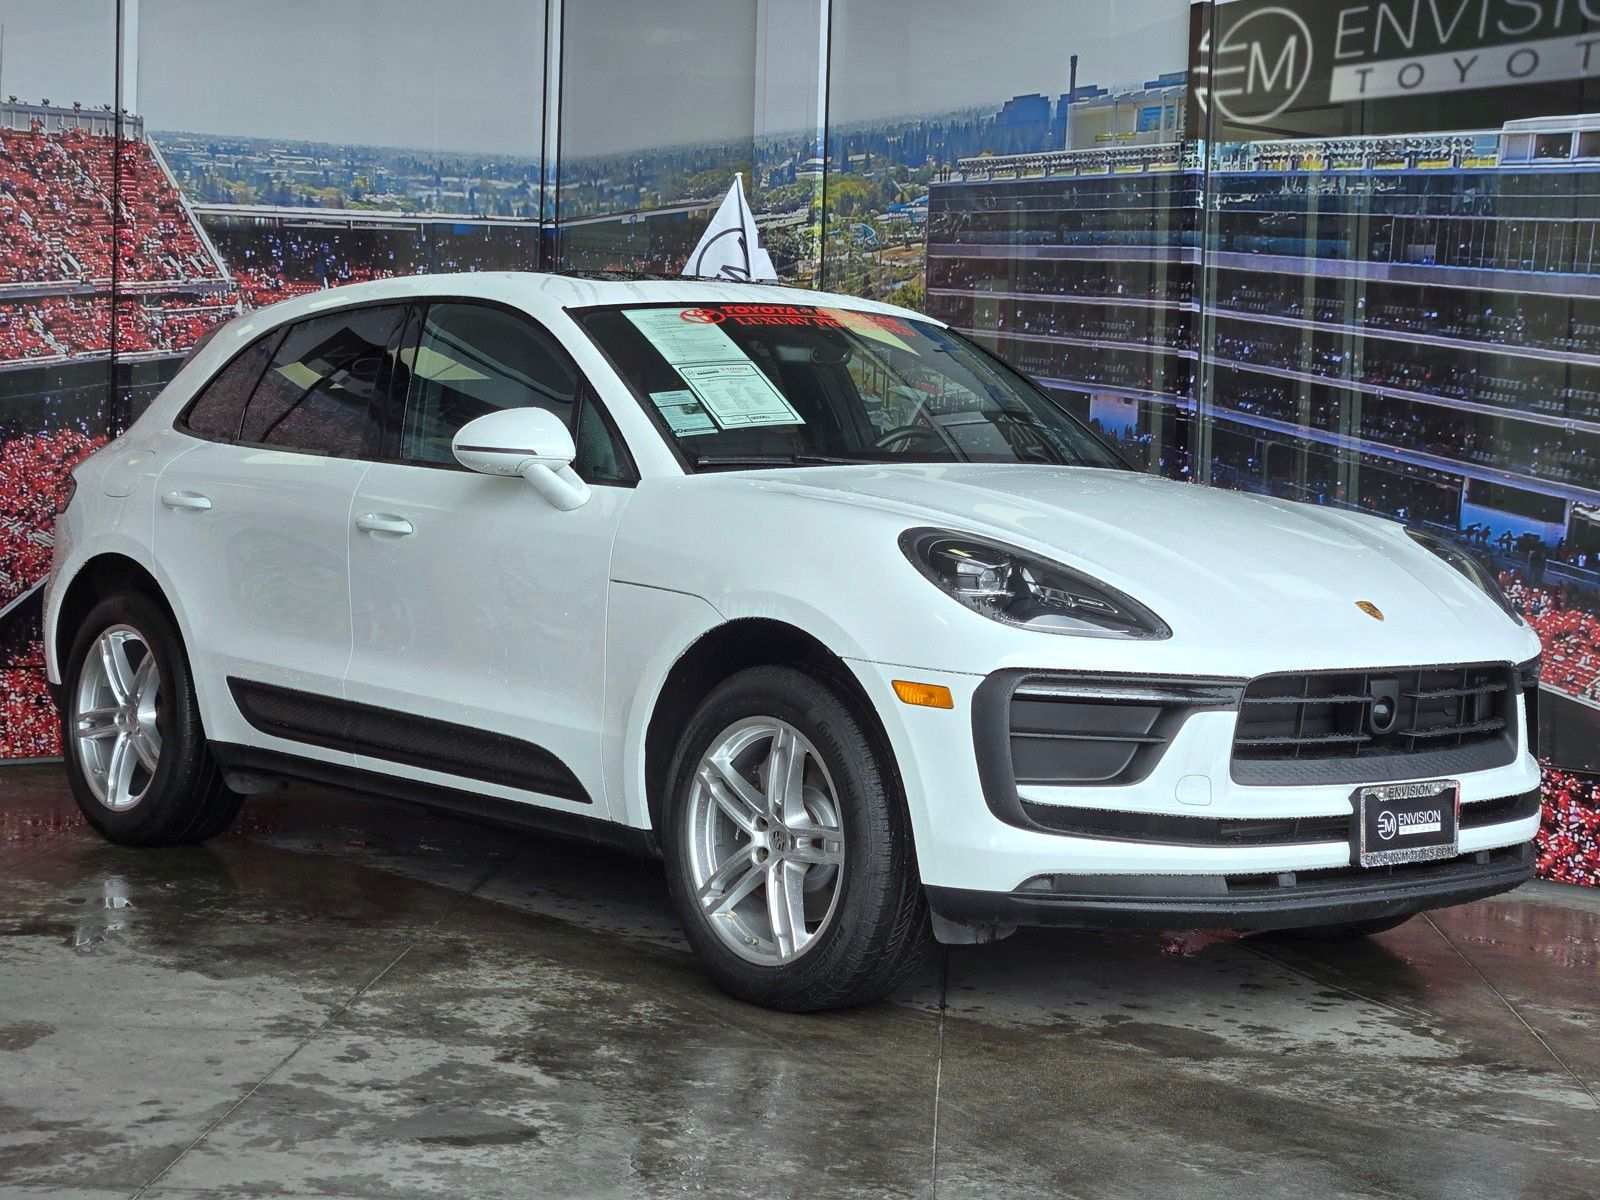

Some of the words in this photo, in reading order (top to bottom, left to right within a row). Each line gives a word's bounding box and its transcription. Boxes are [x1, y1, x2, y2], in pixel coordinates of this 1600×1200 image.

[1334, 0, 1600, 60] ENVISI
[720, 304, 797, 316] TOYOTA
[734, 315, 810, 327] LUXURY
[1388, 785, 1432, 798] ENVISION
[1398, 810, 1441, 826] ENVISION
